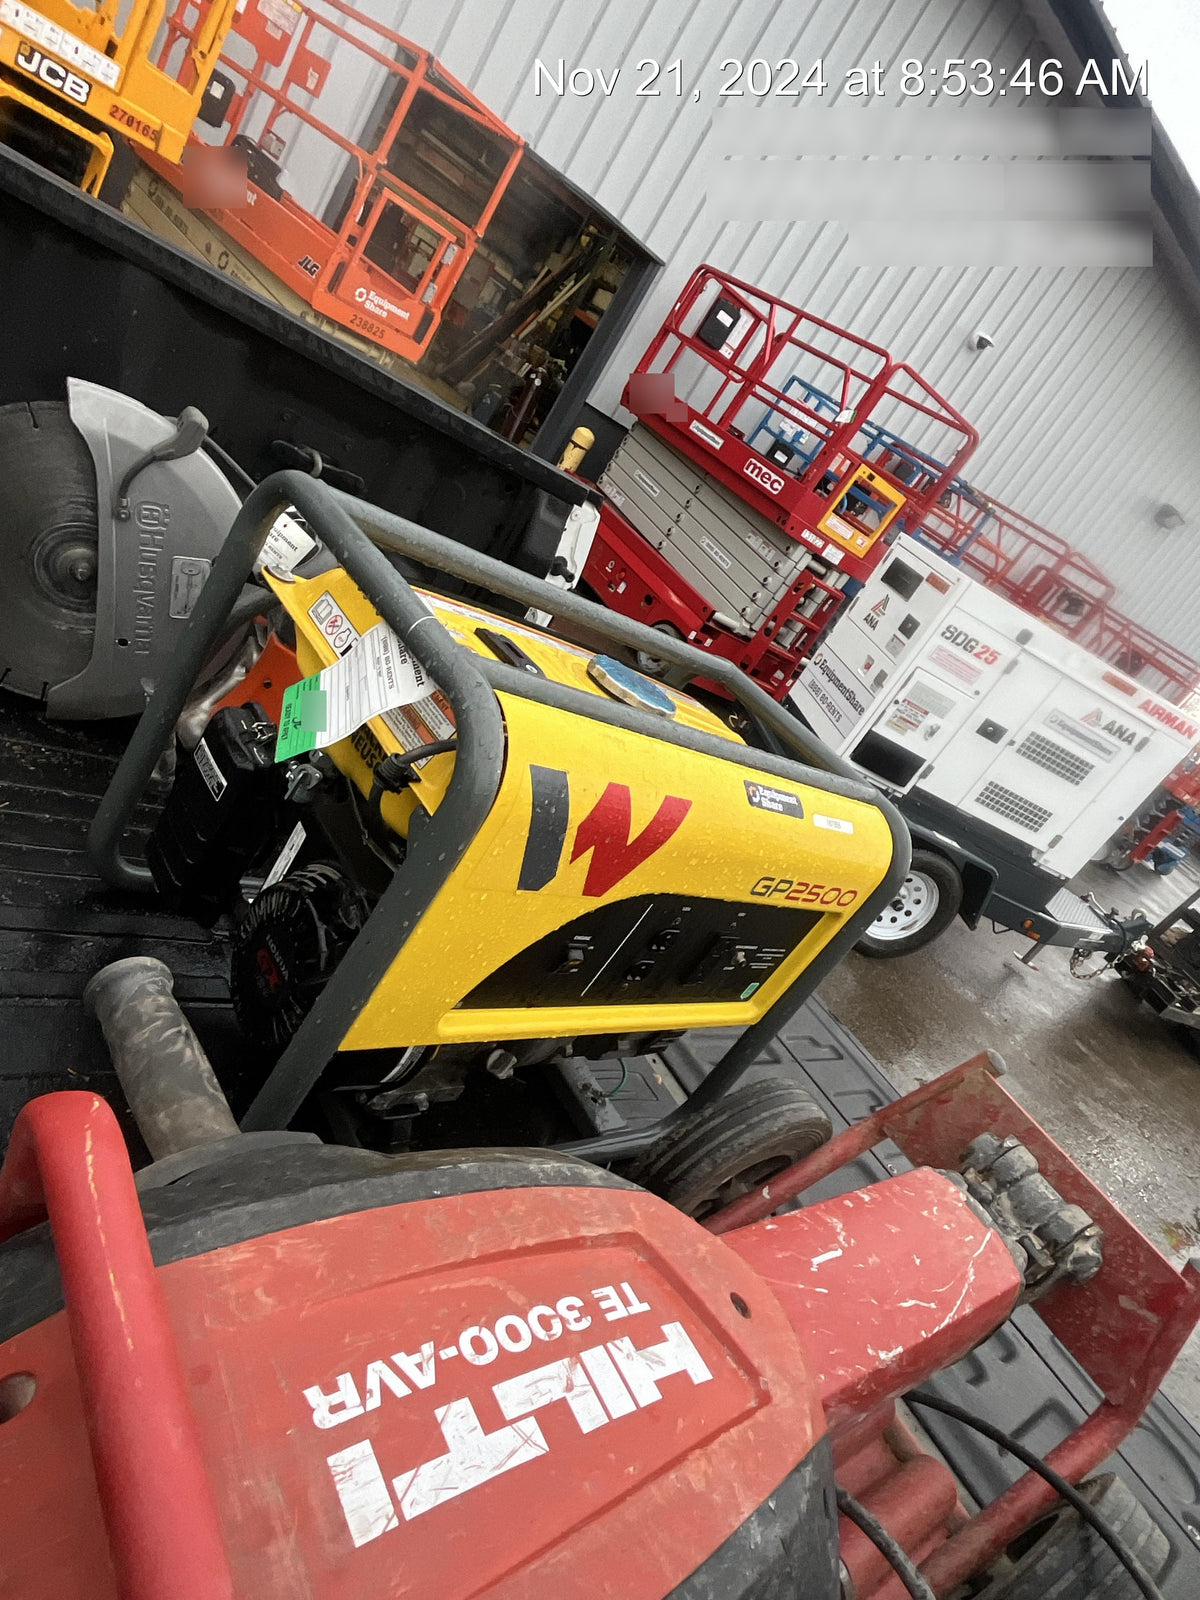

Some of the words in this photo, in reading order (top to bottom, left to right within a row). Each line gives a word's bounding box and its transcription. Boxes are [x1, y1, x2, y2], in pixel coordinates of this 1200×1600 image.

[17, 51, 90, 103] JCB
[109, 105, 160, 141] 270165
[298, 255, 320, 277] JLG
[364, 300, 387, 318] Share
[368, 290, 410, 320] Equipment
[350, 314, 386, 339] 238825
[745, 460, 783, 492] mec
[132, 531, 166, 654] Husqvarna
[863, 612, 880, 631] ANA
[818, 658, 866, 716] EquipmentShare
[1101, 719, 1138, 746] ANA
[1138, 699, 1199, 740] AIRMAN
[750, 876, 858, 907] GP2500
[592, 1281, 651, 1322] TE
[302, 1295, 592, 1430] 3000-AVR
[326, 1320, 714, 1549] HILTI
